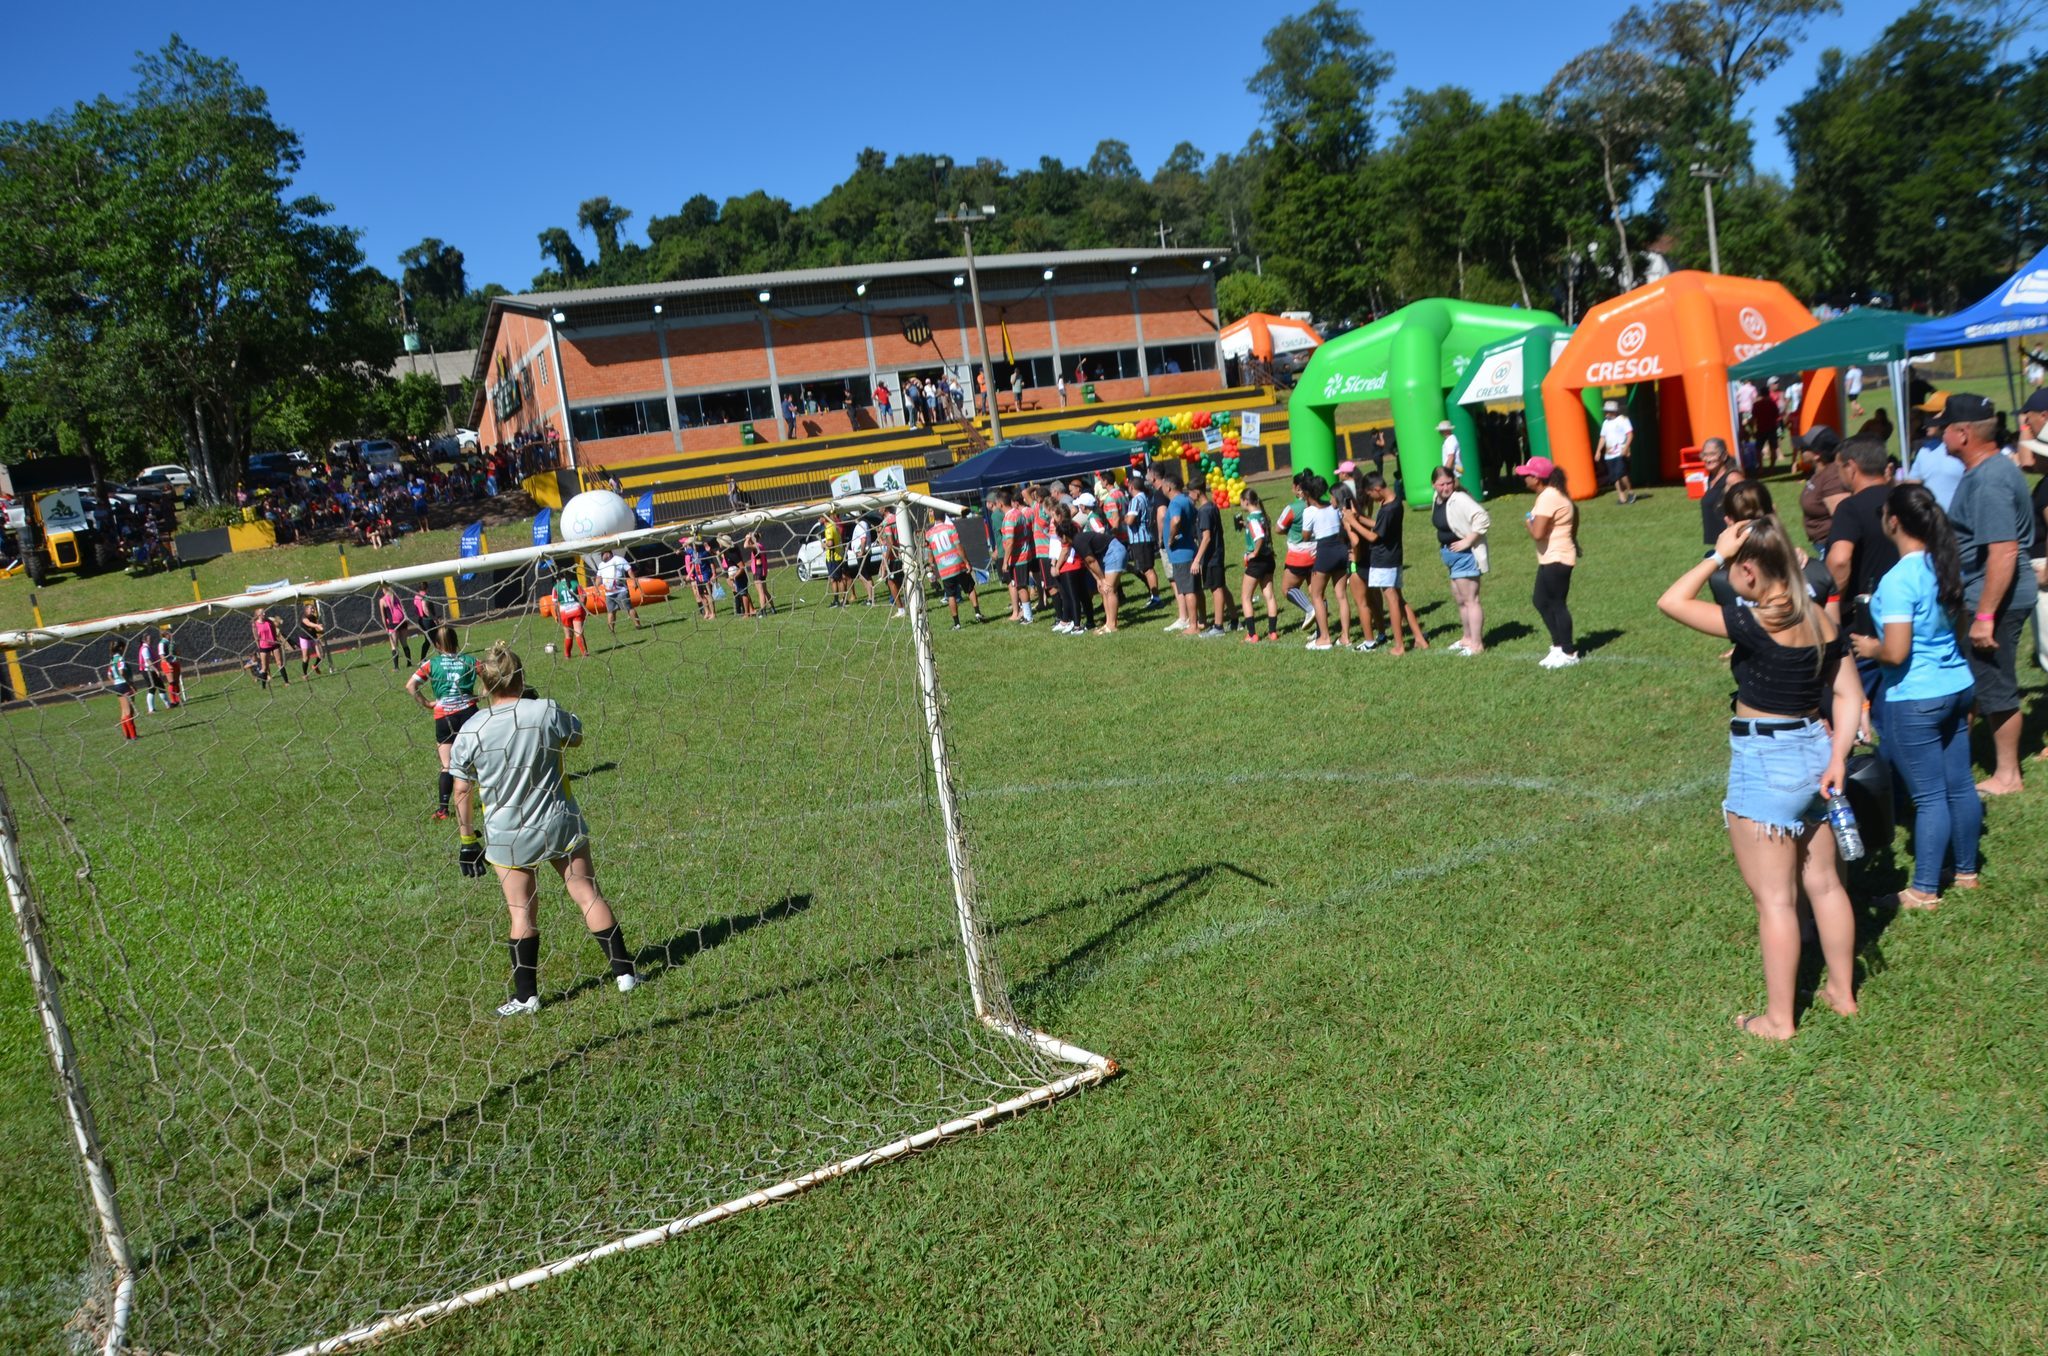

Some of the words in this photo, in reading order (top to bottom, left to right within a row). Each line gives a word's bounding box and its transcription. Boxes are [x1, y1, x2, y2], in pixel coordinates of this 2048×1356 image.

[1586, 355, 1663, 383] CRESOL
[1476, 384, 1510, 398] CRESOL
[931, 529, 951, 553] 10
